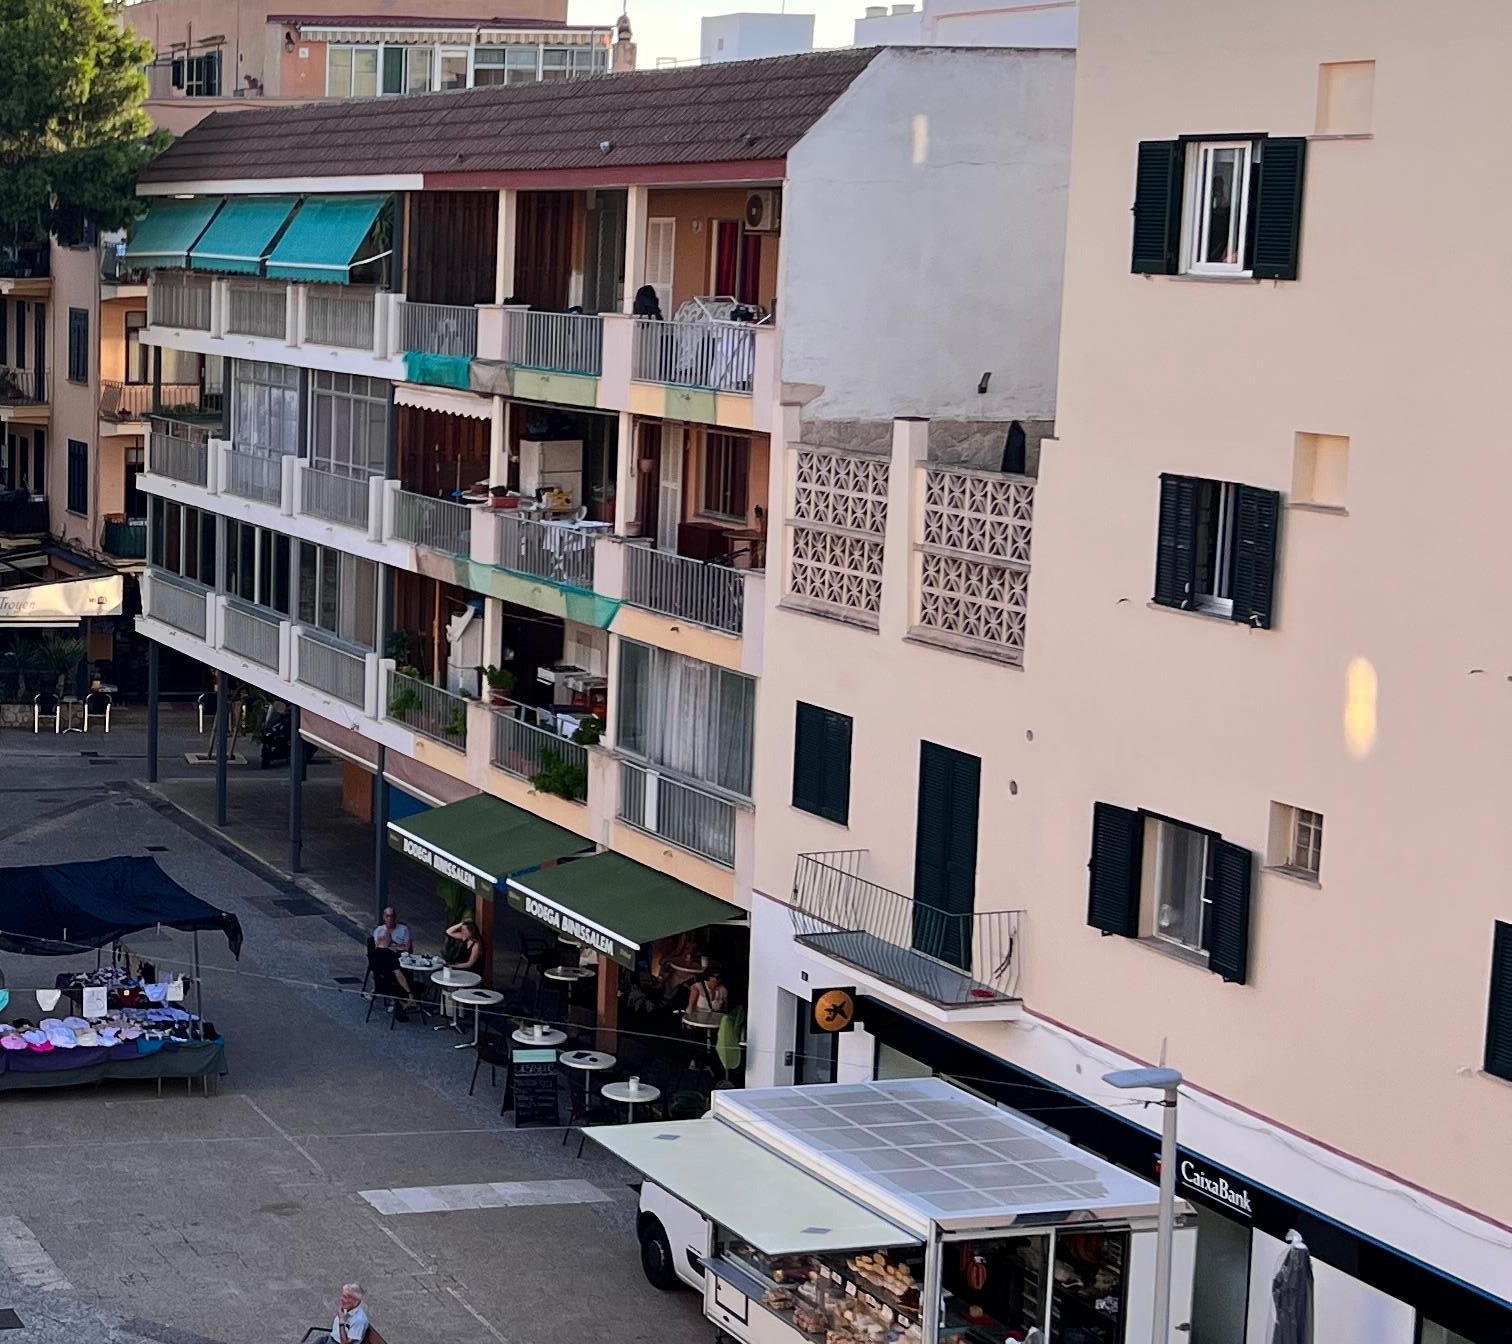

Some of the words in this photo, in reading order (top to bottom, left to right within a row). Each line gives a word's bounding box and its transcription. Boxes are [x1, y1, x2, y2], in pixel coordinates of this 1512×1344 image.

[403, 838, 433, 866] BODEGA
[525, 897, 560, 929] BODEGA
[561, 915, 614, 956] BINISSALEM
[1181, 1160, 1253, 1213] CaixaBank
